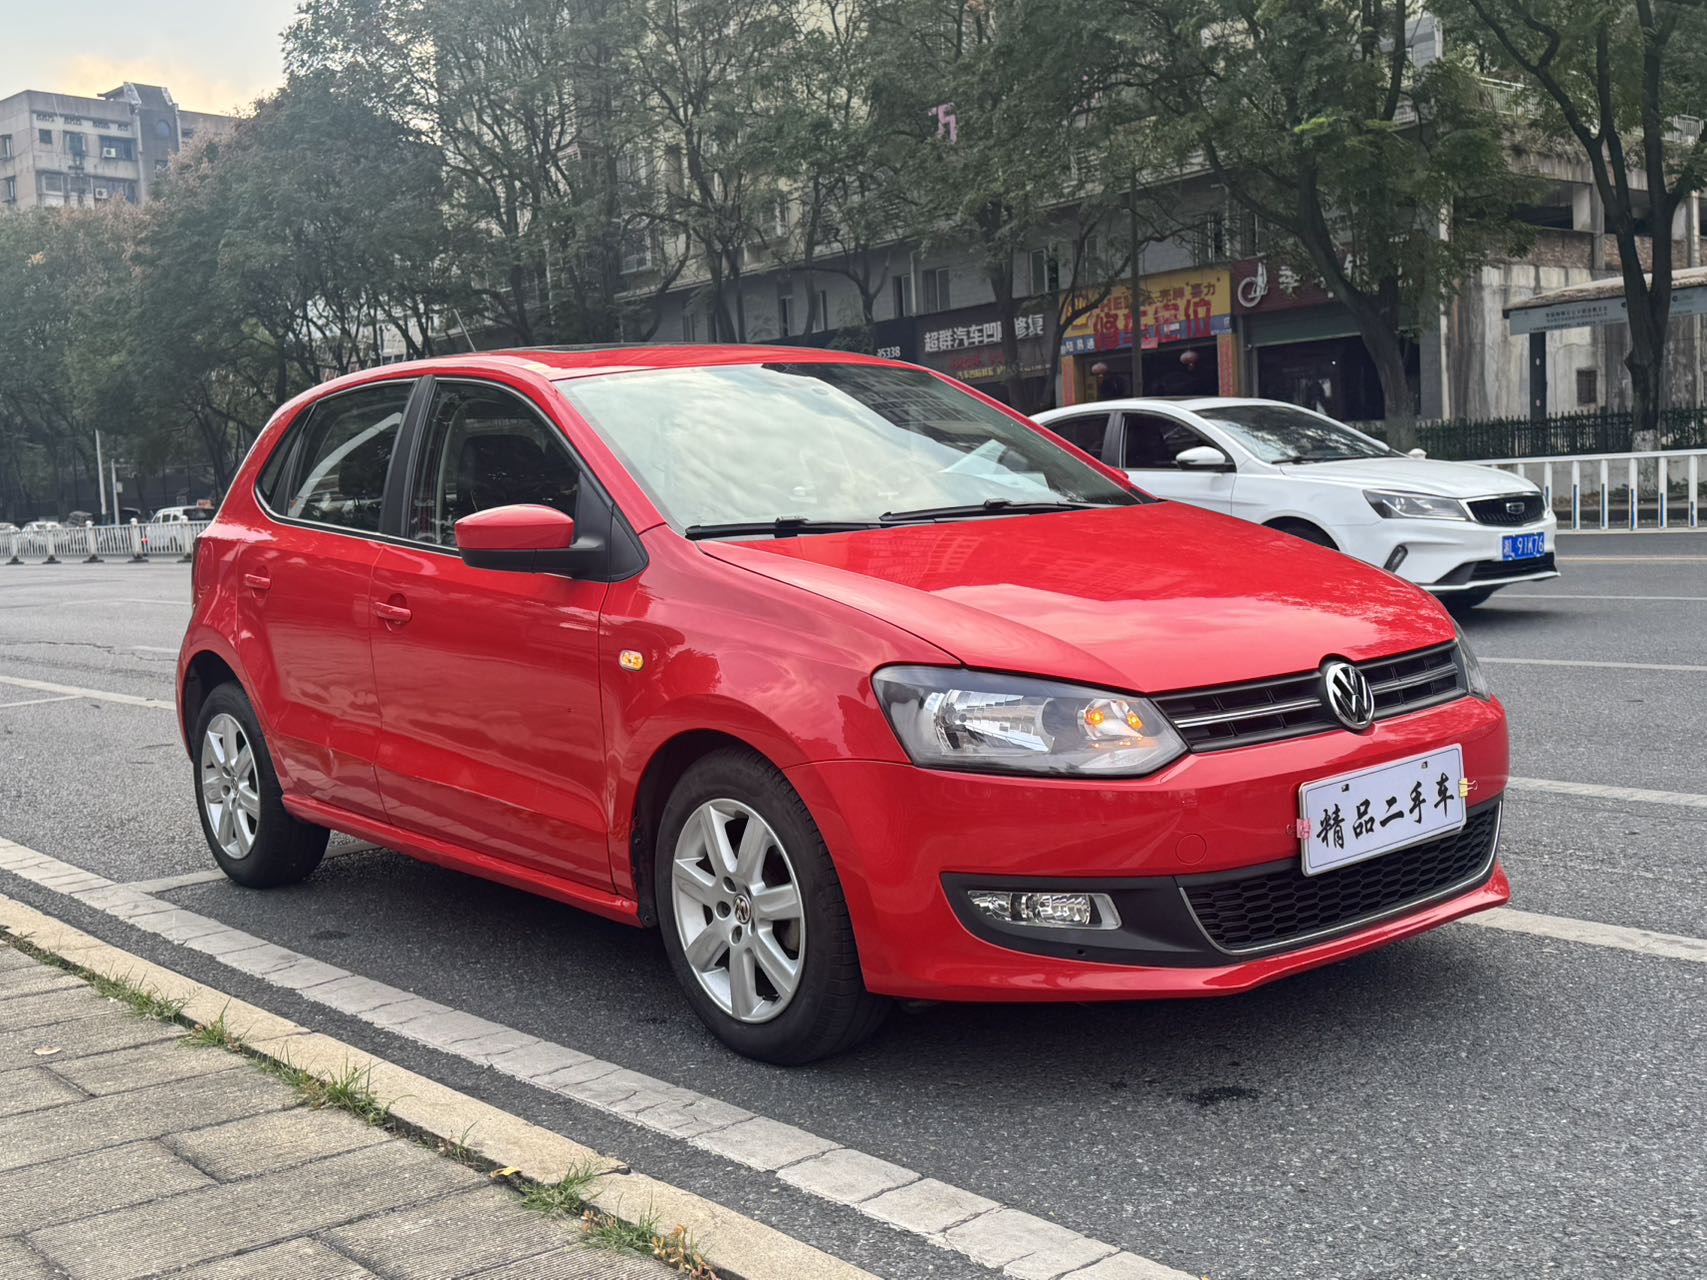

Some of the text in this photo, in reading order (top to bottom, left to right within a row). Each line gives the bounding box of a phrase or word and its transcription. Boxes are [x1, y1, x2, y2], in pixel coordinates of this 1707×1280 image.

[924, 313, 1044, 353] 超群汽车凹修复
[1316, 771, 1455, 850] 精品二手车
